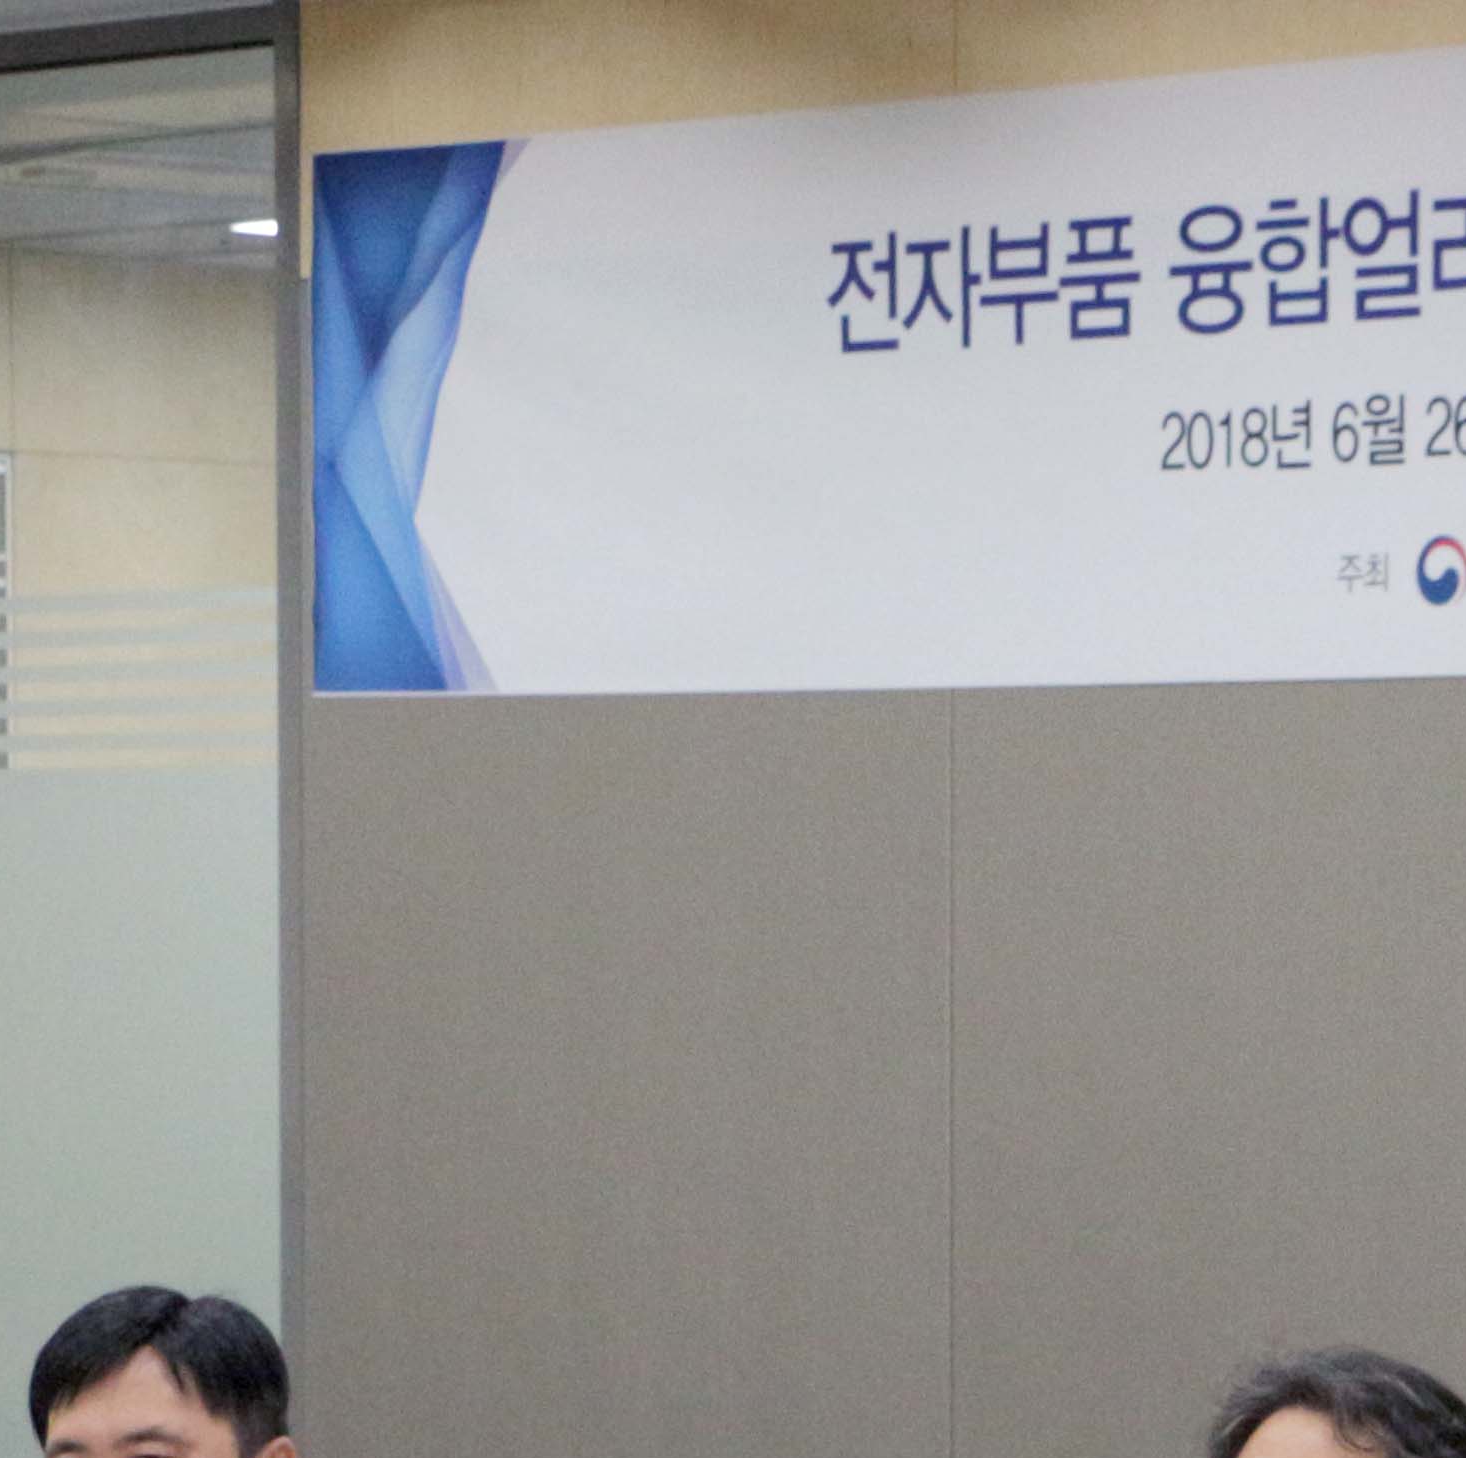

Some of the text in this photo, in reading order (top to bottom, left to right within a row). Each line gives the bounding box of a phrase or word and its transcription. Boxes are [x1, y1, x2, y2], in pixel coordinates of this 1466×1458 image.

[827, 215, 1141, 354] 전자부품
[1160, 399, 1312, 471] 2018년
[1331, 393, 1405, 467] 6월
[1336, 553, 1389, 593] 주최
